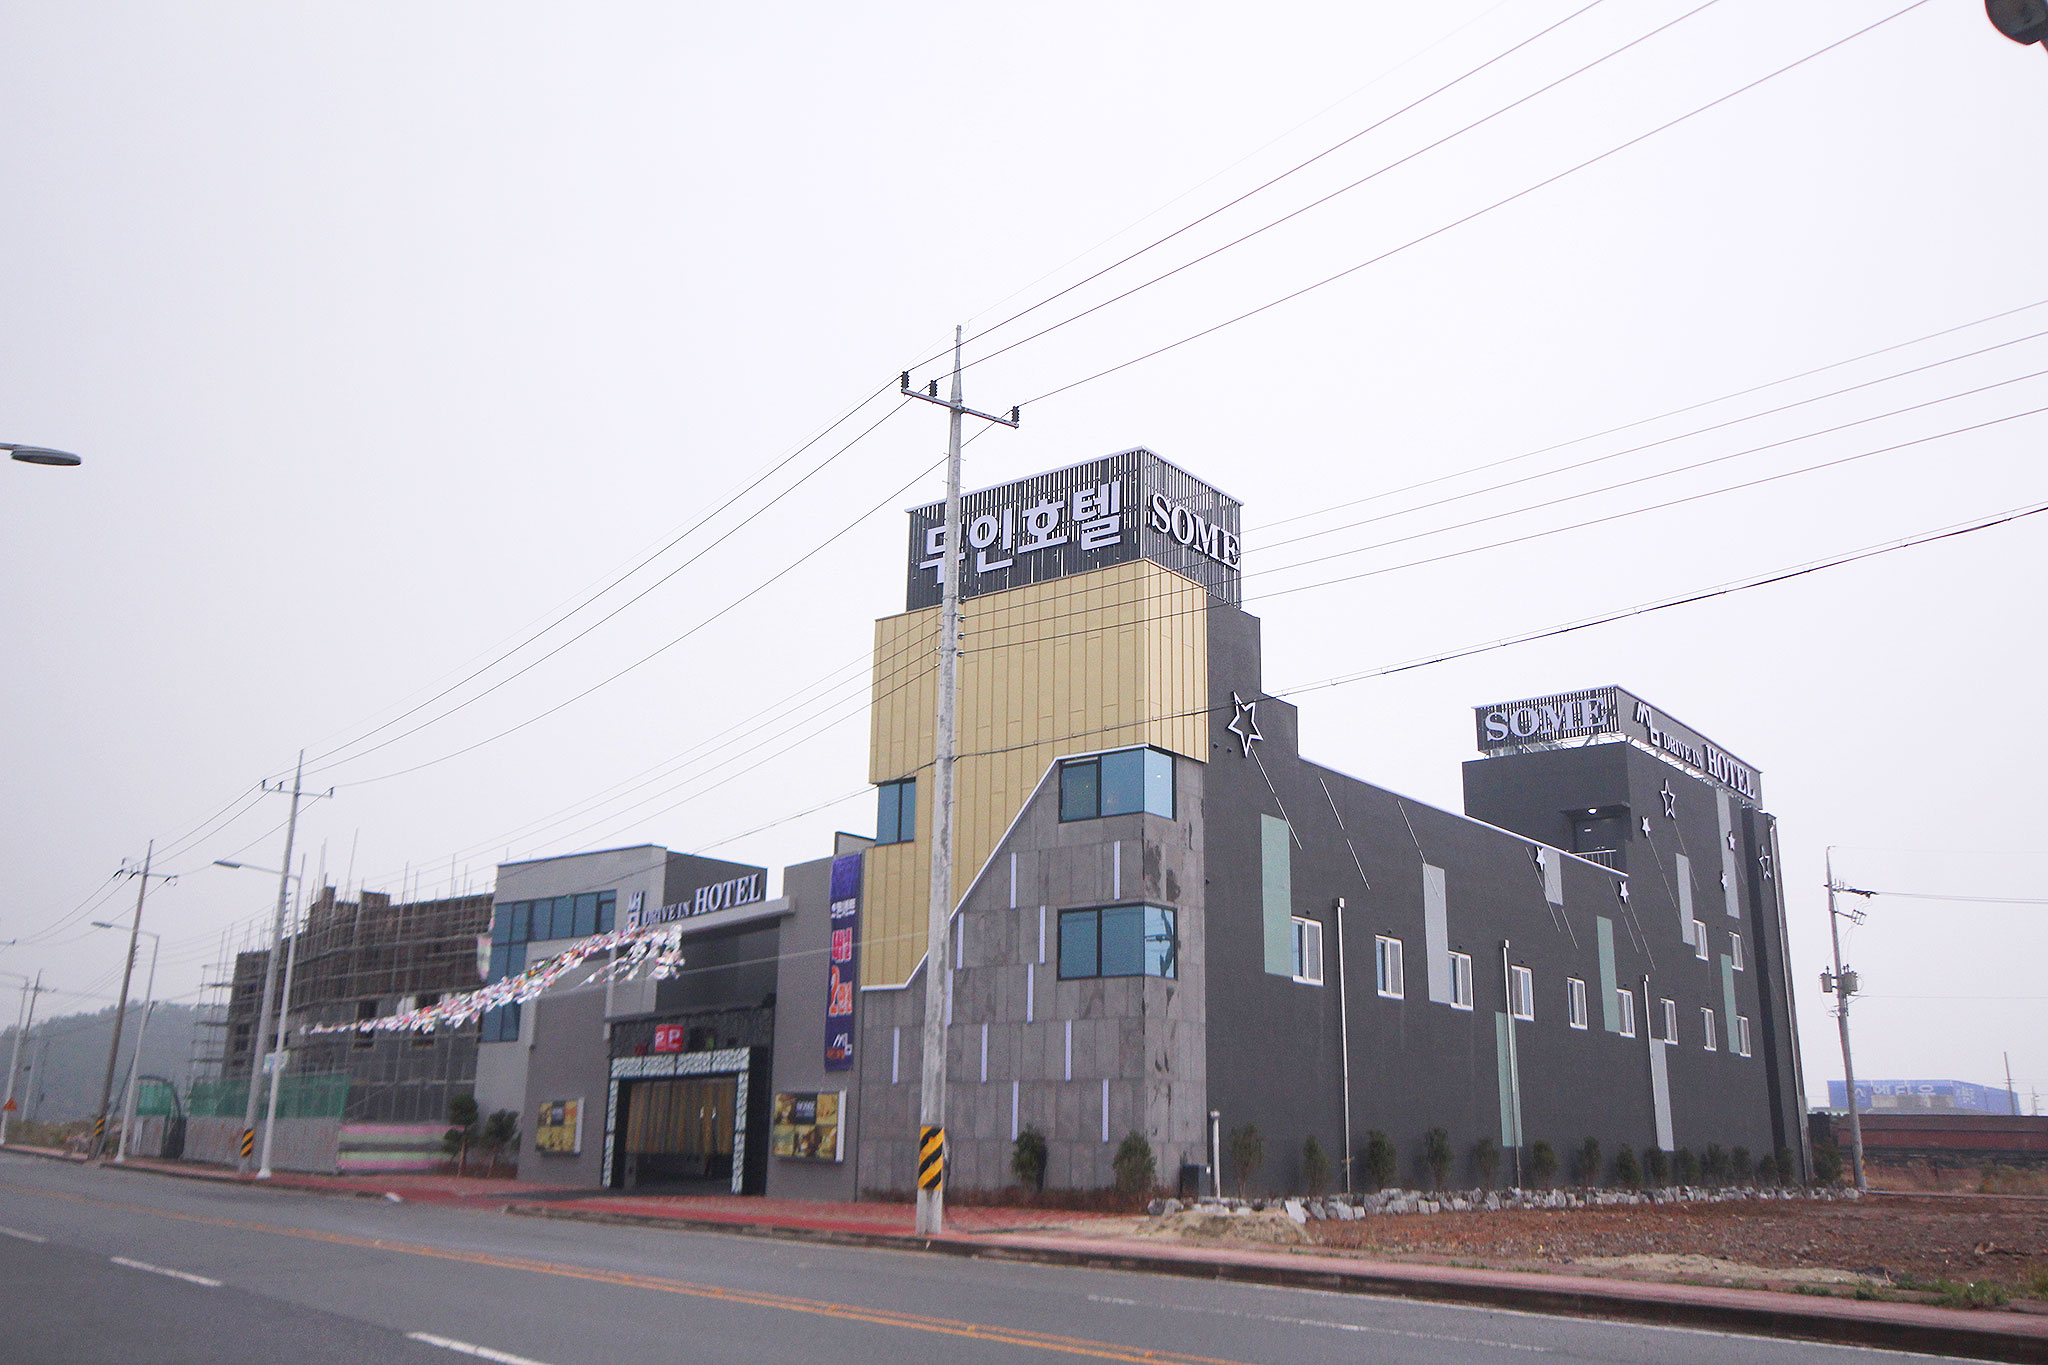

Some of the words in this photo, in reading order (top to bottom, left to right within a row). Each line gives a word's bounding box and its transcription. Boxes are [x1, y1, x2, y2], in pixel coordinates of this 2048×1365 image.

[919, 481, 1120, 584] 무인호텔
[1151, 492, 1240, 572] SOME
[1485, 697, 1609, 741] SOME
[1662, 732, 1692, 762] DRIVE
[1704, 744, 1755, 800] HOTEL
[692, 873, 761, 916] HOTEL
[667, 1029, 681, 1044] P
